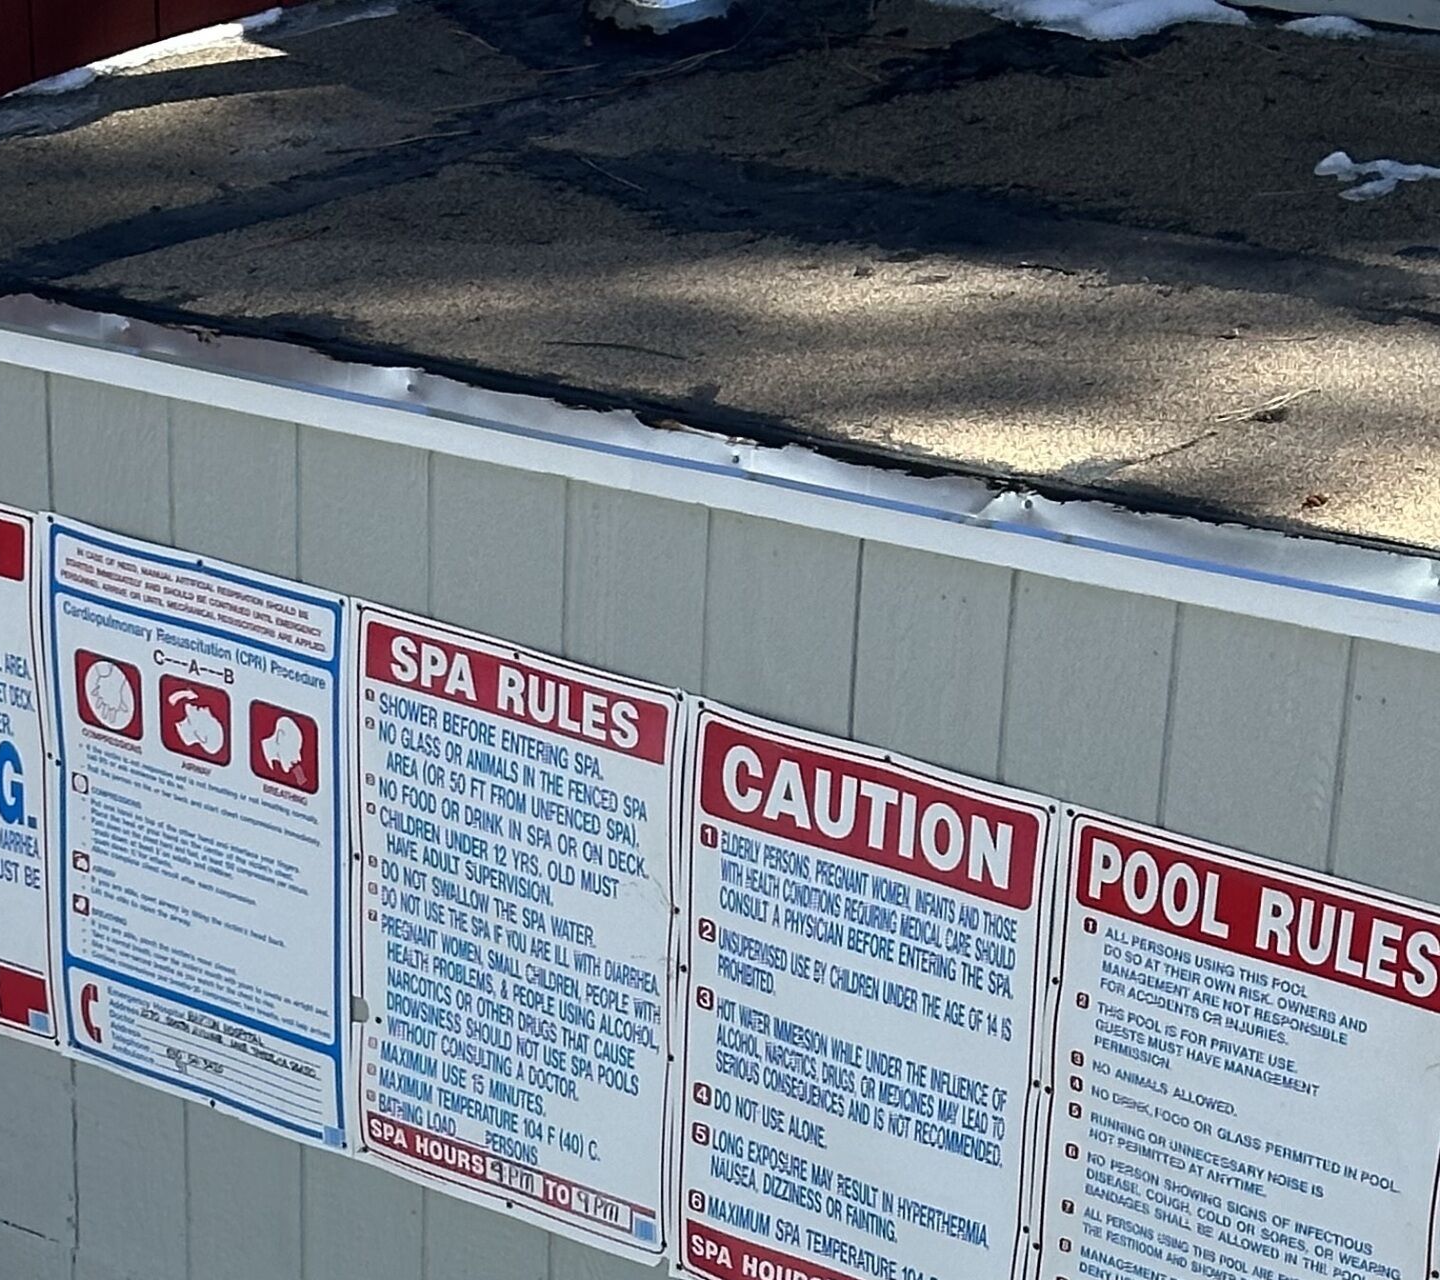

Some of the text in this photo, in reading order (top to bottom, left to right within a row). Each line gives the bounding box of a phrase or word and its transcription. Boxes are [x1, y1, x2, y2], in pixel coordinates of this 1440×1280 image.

[62, 600, 326, 690] Cardiopulmonary Resuscitation (CPR) Procedure
[379, 692, 604, 781] SHOWER BEFORE ENTERING SPA.
[390, 635, 639, 749] SPA RULES
[378, 776, 650, 879] NO FOOD OR DRINK IN SPA OR ON DECK.
[379, 806, 620, 899] CHILDREN UNDER 12 YRS. OLD MUST
[722, 745, 1013, 890] CAUTION
[23, 865, 41, 890] BE
[386, 833, 554, 907] HAVE ADULT SUPERVISION.
[719, 885, 1014, 1000] CONSULT A PHYSICIAN BEFORE ENTERING THE SPA.
[1088, 837, 1440, 998] POOL RULES
[1103, 943, 1368, 1034] DO SO AT THEIR OWN RISK. OWNERS AND
[1104, 927, 1308, 999] ALL PERSONS USING THIS POOL
[379, 1066, 601, 1162] MAXIMUM TEMPERATURE 104 F (40) C.
[714, 1087, 828, 1150] DO NOT USE ALONE.
[370, 1118, 408, 1149] SPA
[415, 1134, 485, 1175] HOURS
[545, 1179, 570, 1205] TO
[691, 1234, 733, 1269] SPA
[707, 1195, 771, 1237] MAXIMUM
[775, 1219, 800, 1247] SPA
